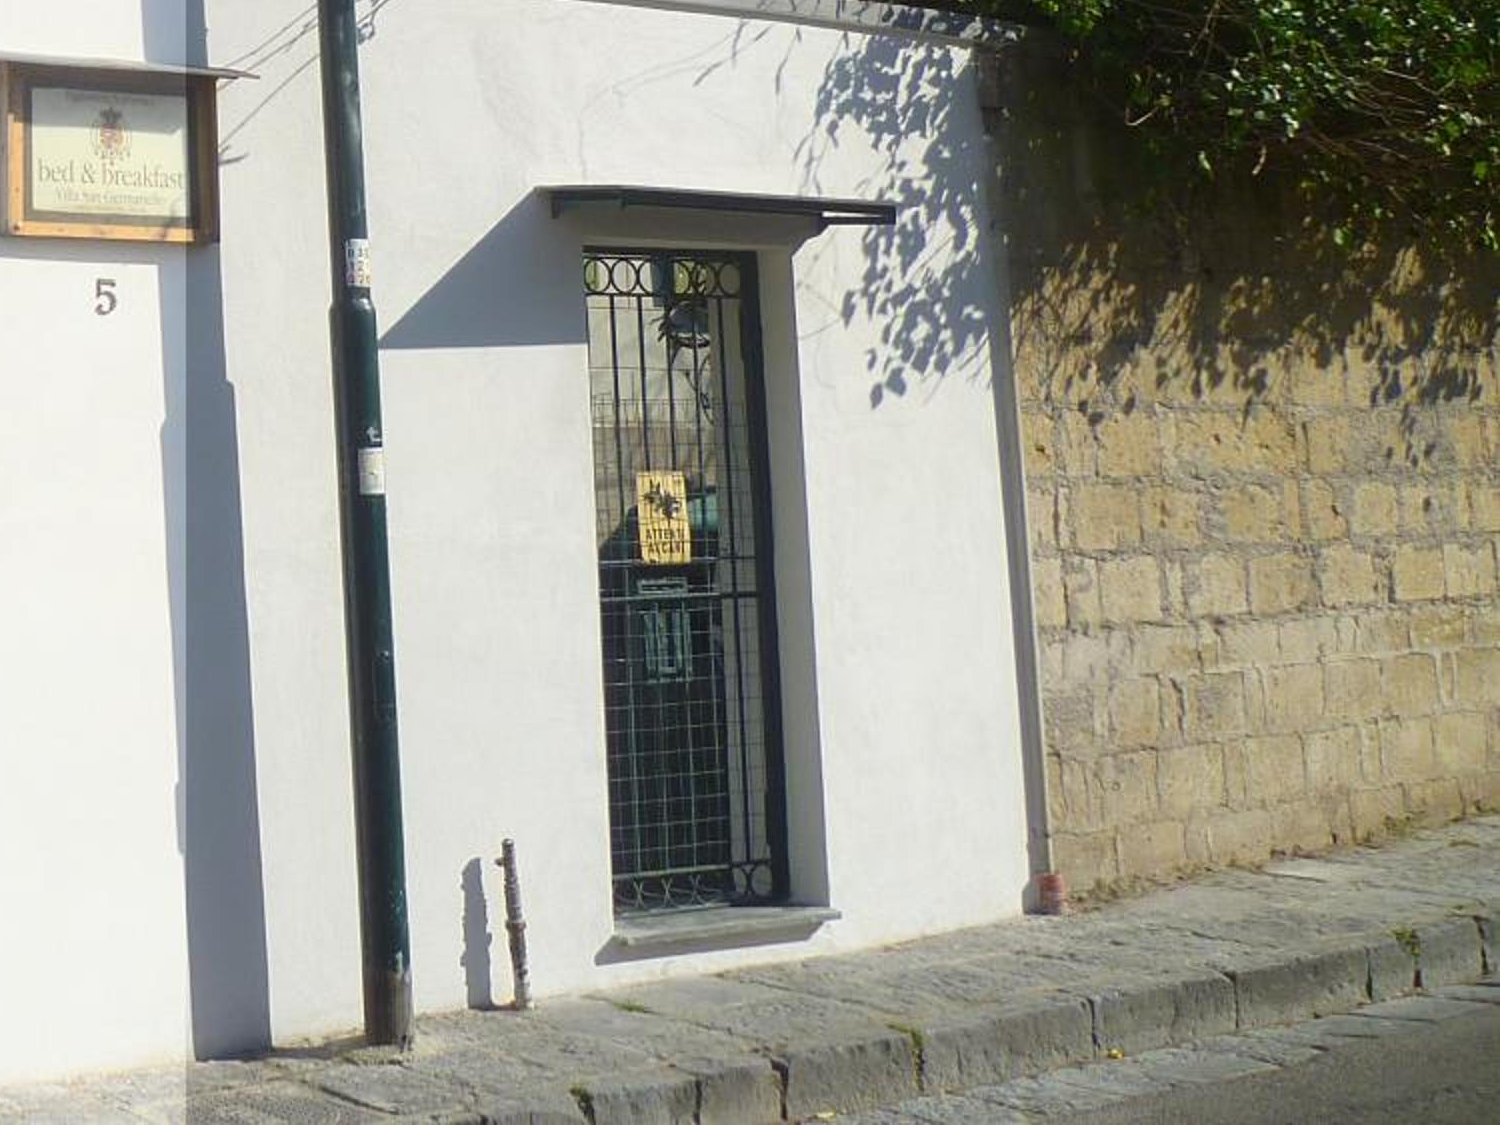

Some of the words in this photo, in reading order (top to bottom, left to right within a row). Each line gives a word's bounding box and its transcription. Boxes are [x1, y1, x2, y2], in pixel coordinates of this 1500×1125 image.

[38, 158, 74, 183] bed
[81, 161, 96, 185] &
[101, 161, 183, 189] breakfast
[94, 277, 117, 316] 5
